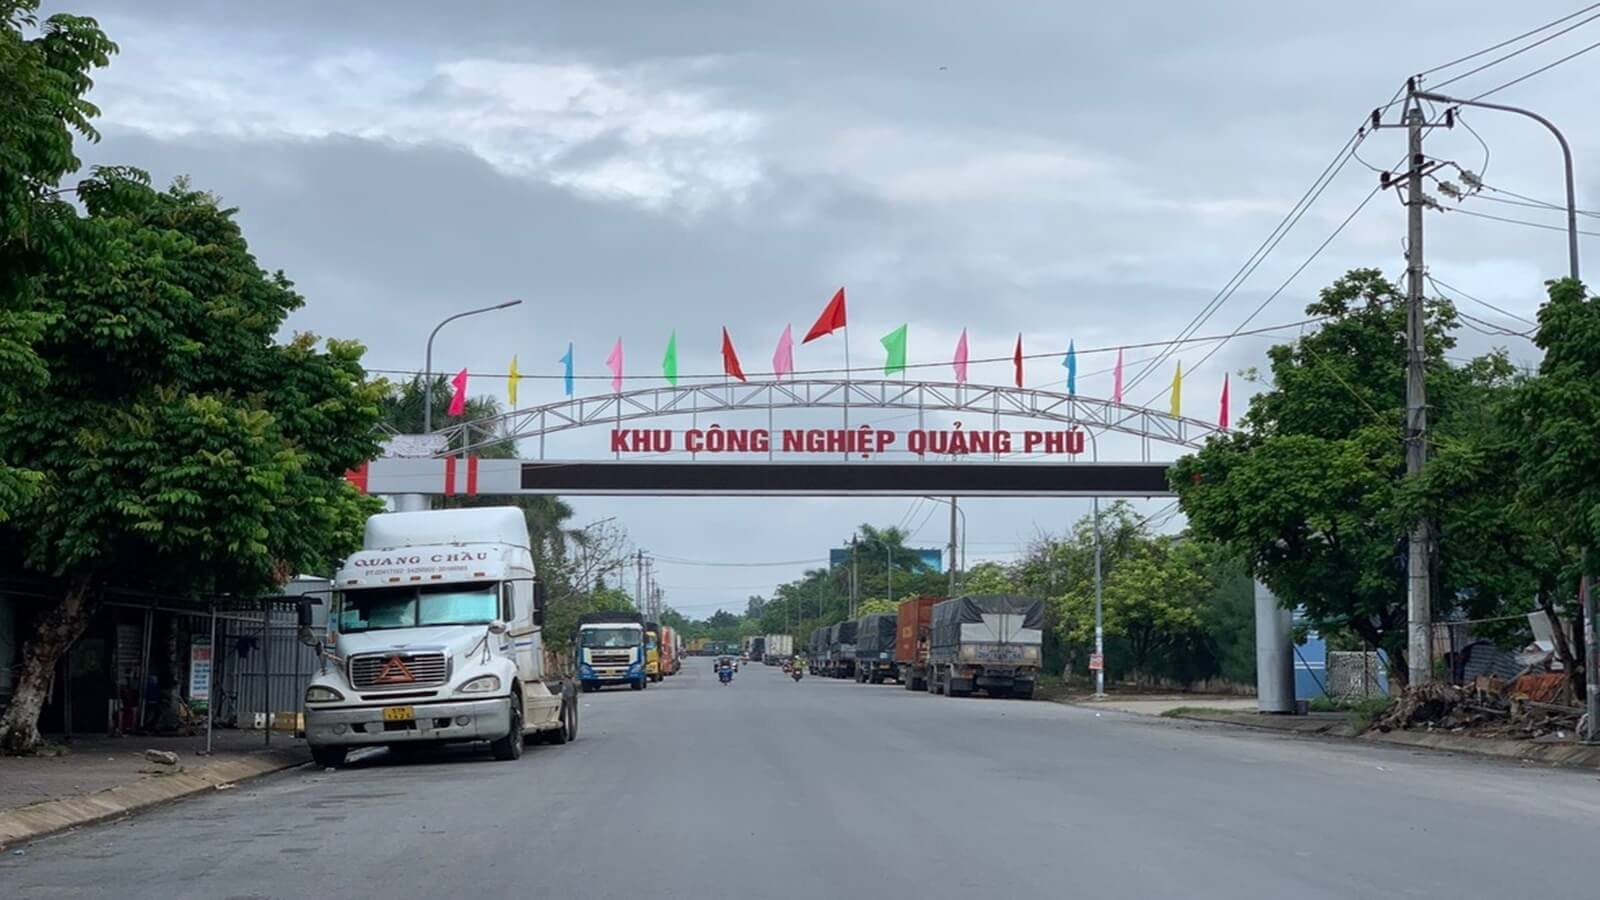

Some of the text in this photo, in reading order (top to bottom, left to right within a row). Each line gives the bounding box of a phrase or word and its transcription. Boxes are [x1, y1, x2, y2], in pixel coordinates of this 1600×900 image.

[610, 421, 1085, 458] KHU CÔNG NGHIỆP QUẢNG PHÚ
